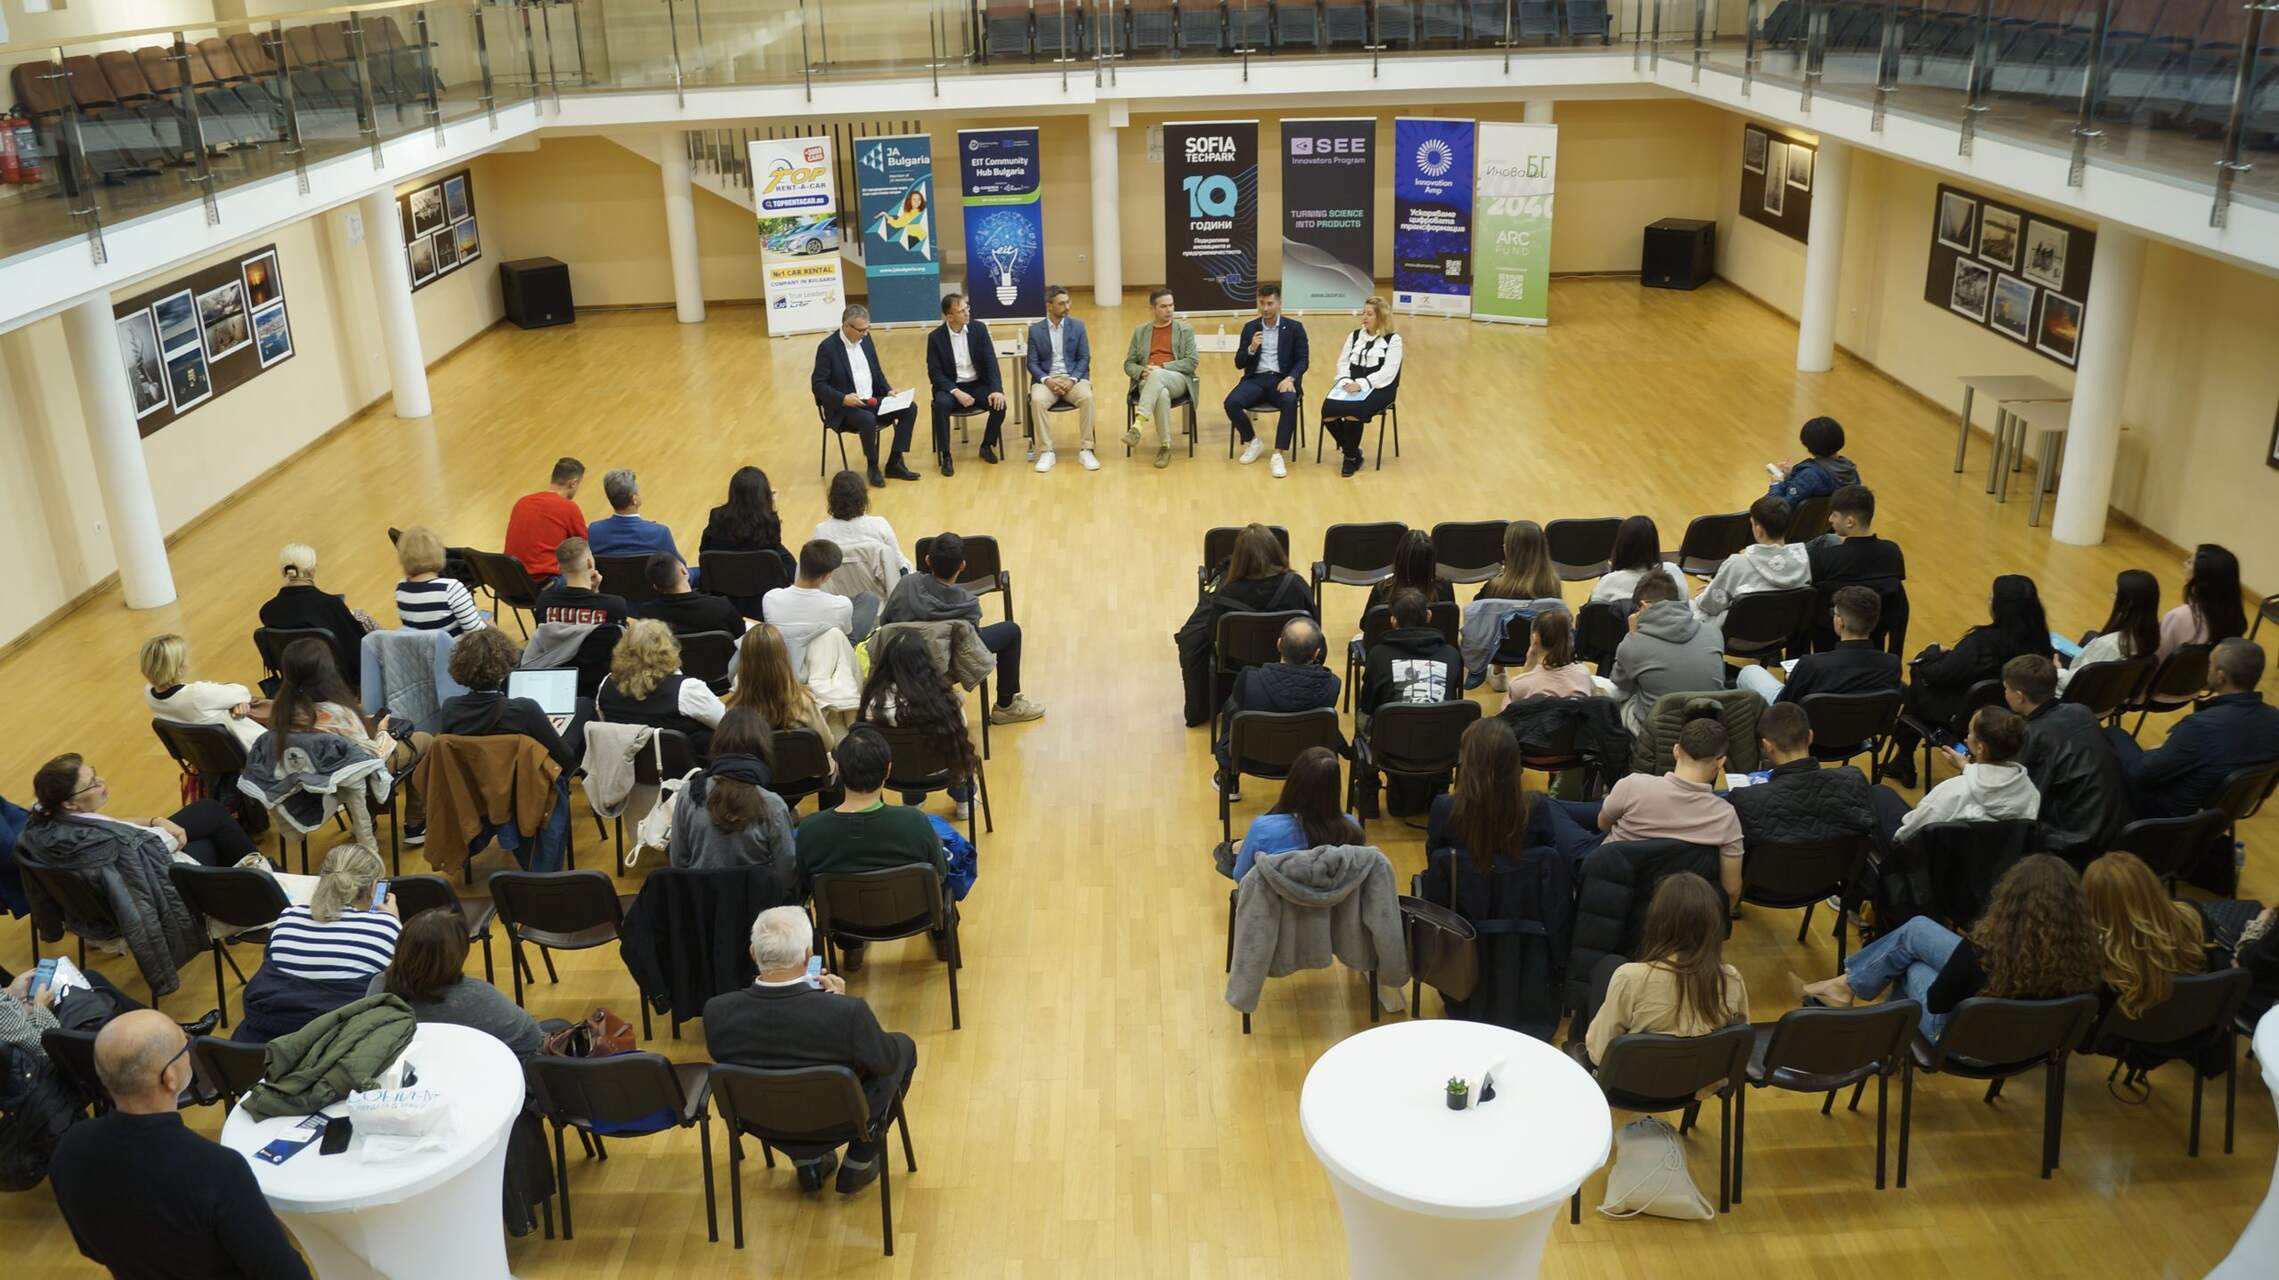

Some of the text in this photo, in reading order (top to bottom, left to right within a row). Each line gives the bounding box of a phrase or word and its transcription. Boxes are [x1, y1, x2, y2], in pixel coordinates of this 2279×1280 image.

[1185, 136, 1236, 153] SOFIA
[1316, 138, 1366, 153] SEE
[886, 147, 900, 157] JA
[888, 155, 930, 167] Bulgaria
[971, 156, 1028, 166] EIT Community
[1334, 157, 1366, 165] Program
[976, 167, 1025, 178] Hub Bulgaria
[763, 167, 826, 194] TOP
[1414, 178, 1453, 187] Innovation
[776, 182, 826, 192] RENT-A-CAR
[1424, 186, 1442, 195] Amp
[1291, 209, 1364, 218] TURNING SCIENCE
[1190, 221, 1232, 231] ГОДИНИ
[1296, 220, 1361, 229] INTO PRODUCTS
[1496, 230, 1530, 246] ARC
[1496, 246, 1529, 256] FUND
[546, 607, 607, 624] HUGO
